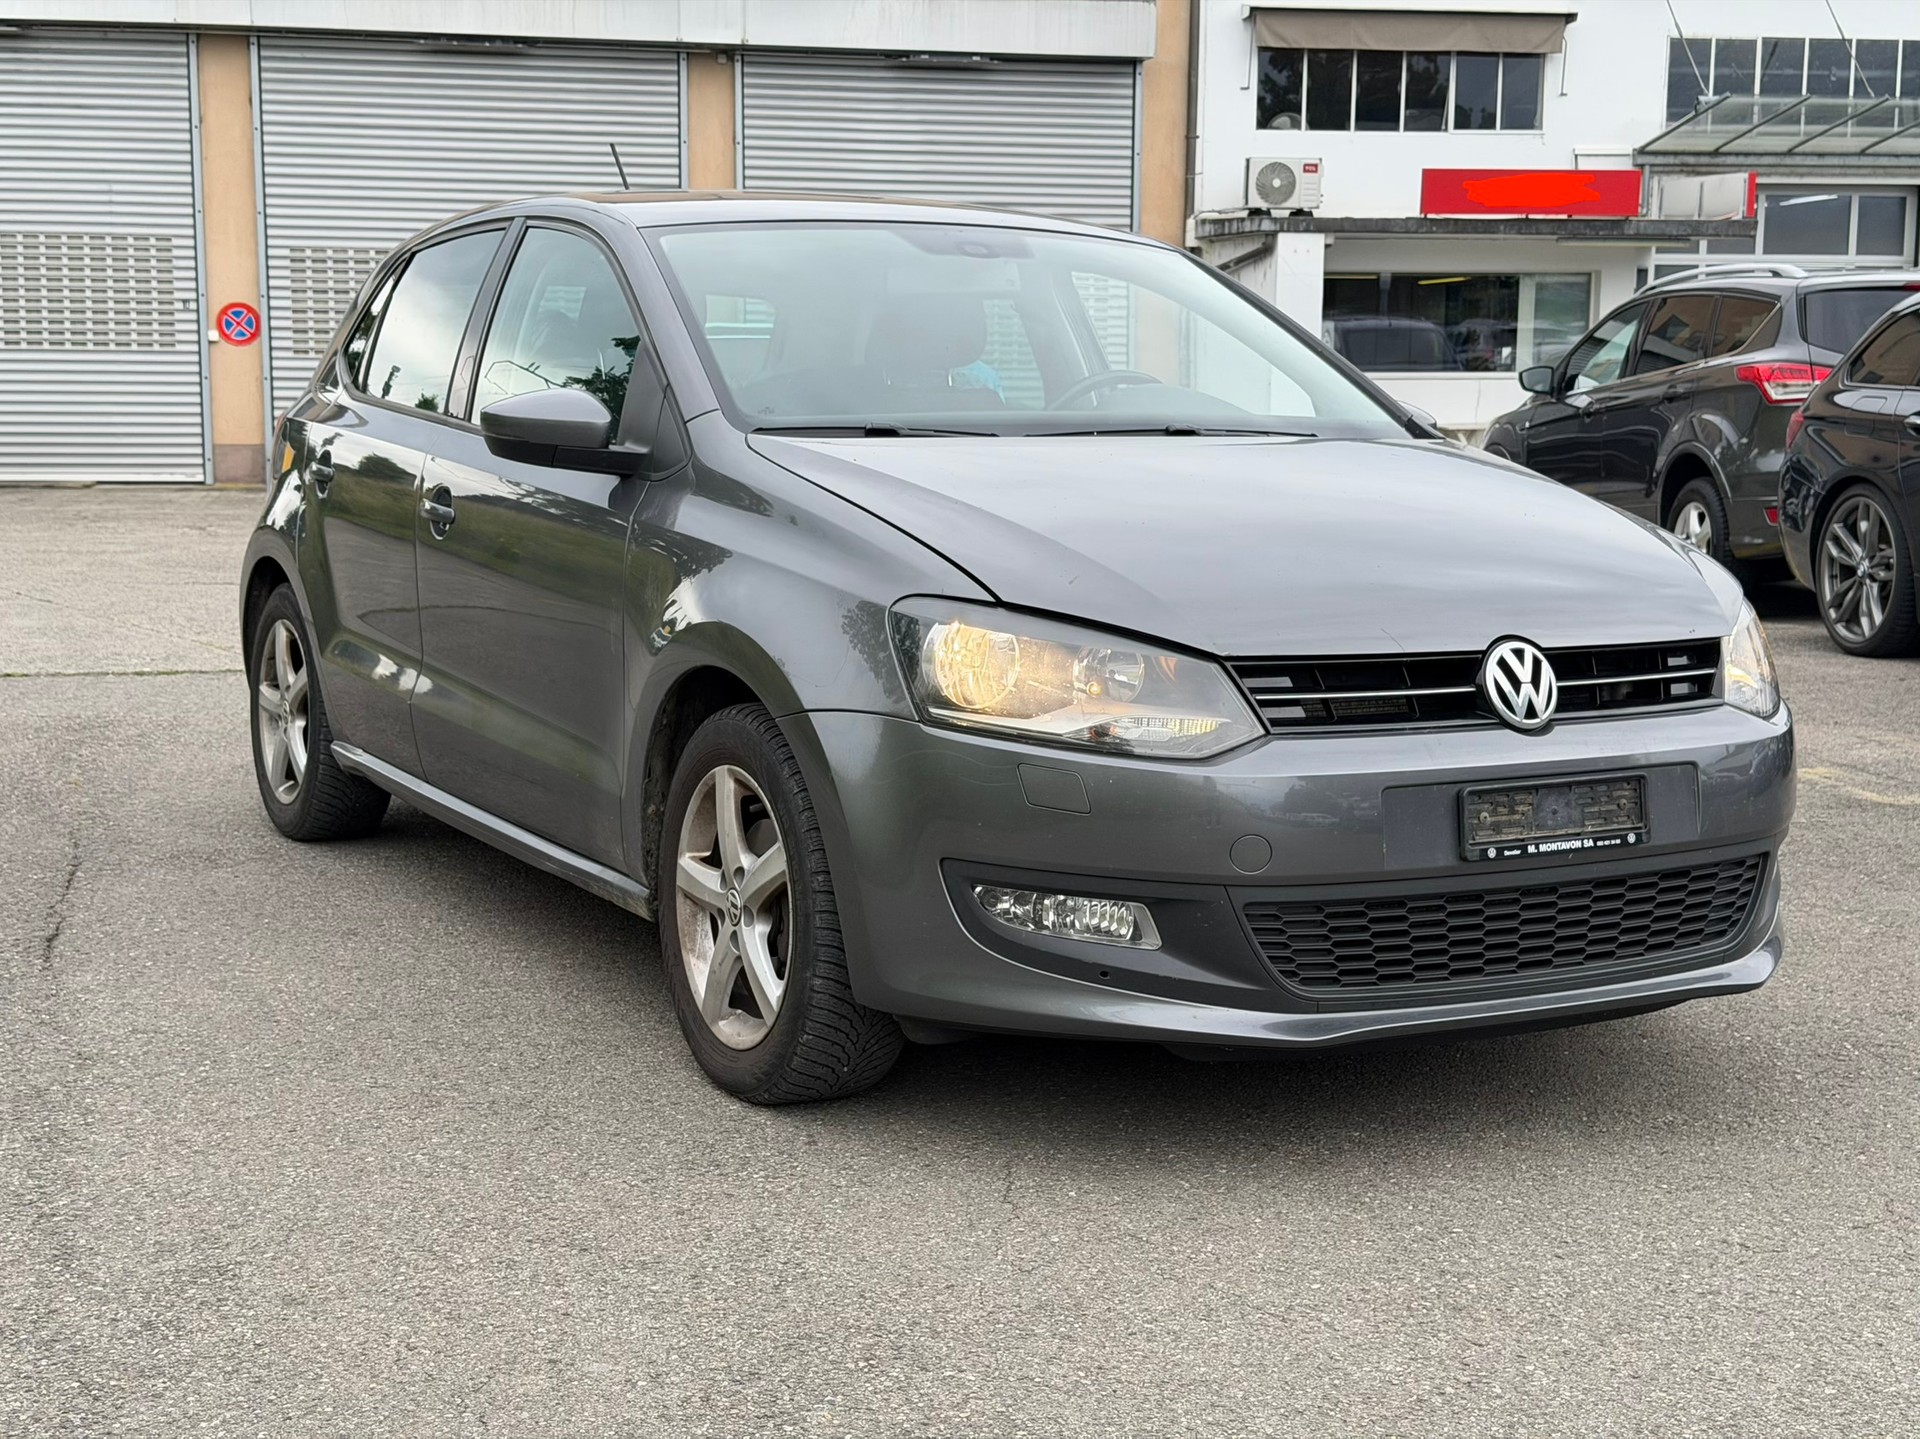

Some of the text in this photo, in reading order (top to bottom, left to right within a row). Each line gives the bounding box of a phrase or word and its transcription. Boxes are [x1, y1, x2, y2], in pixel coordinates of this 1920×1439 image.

[1527, 844, 1538, 854] M.
[1538, 840, 1582, 853] MONTAVON
[1583, 838, 1595, 848] SA
